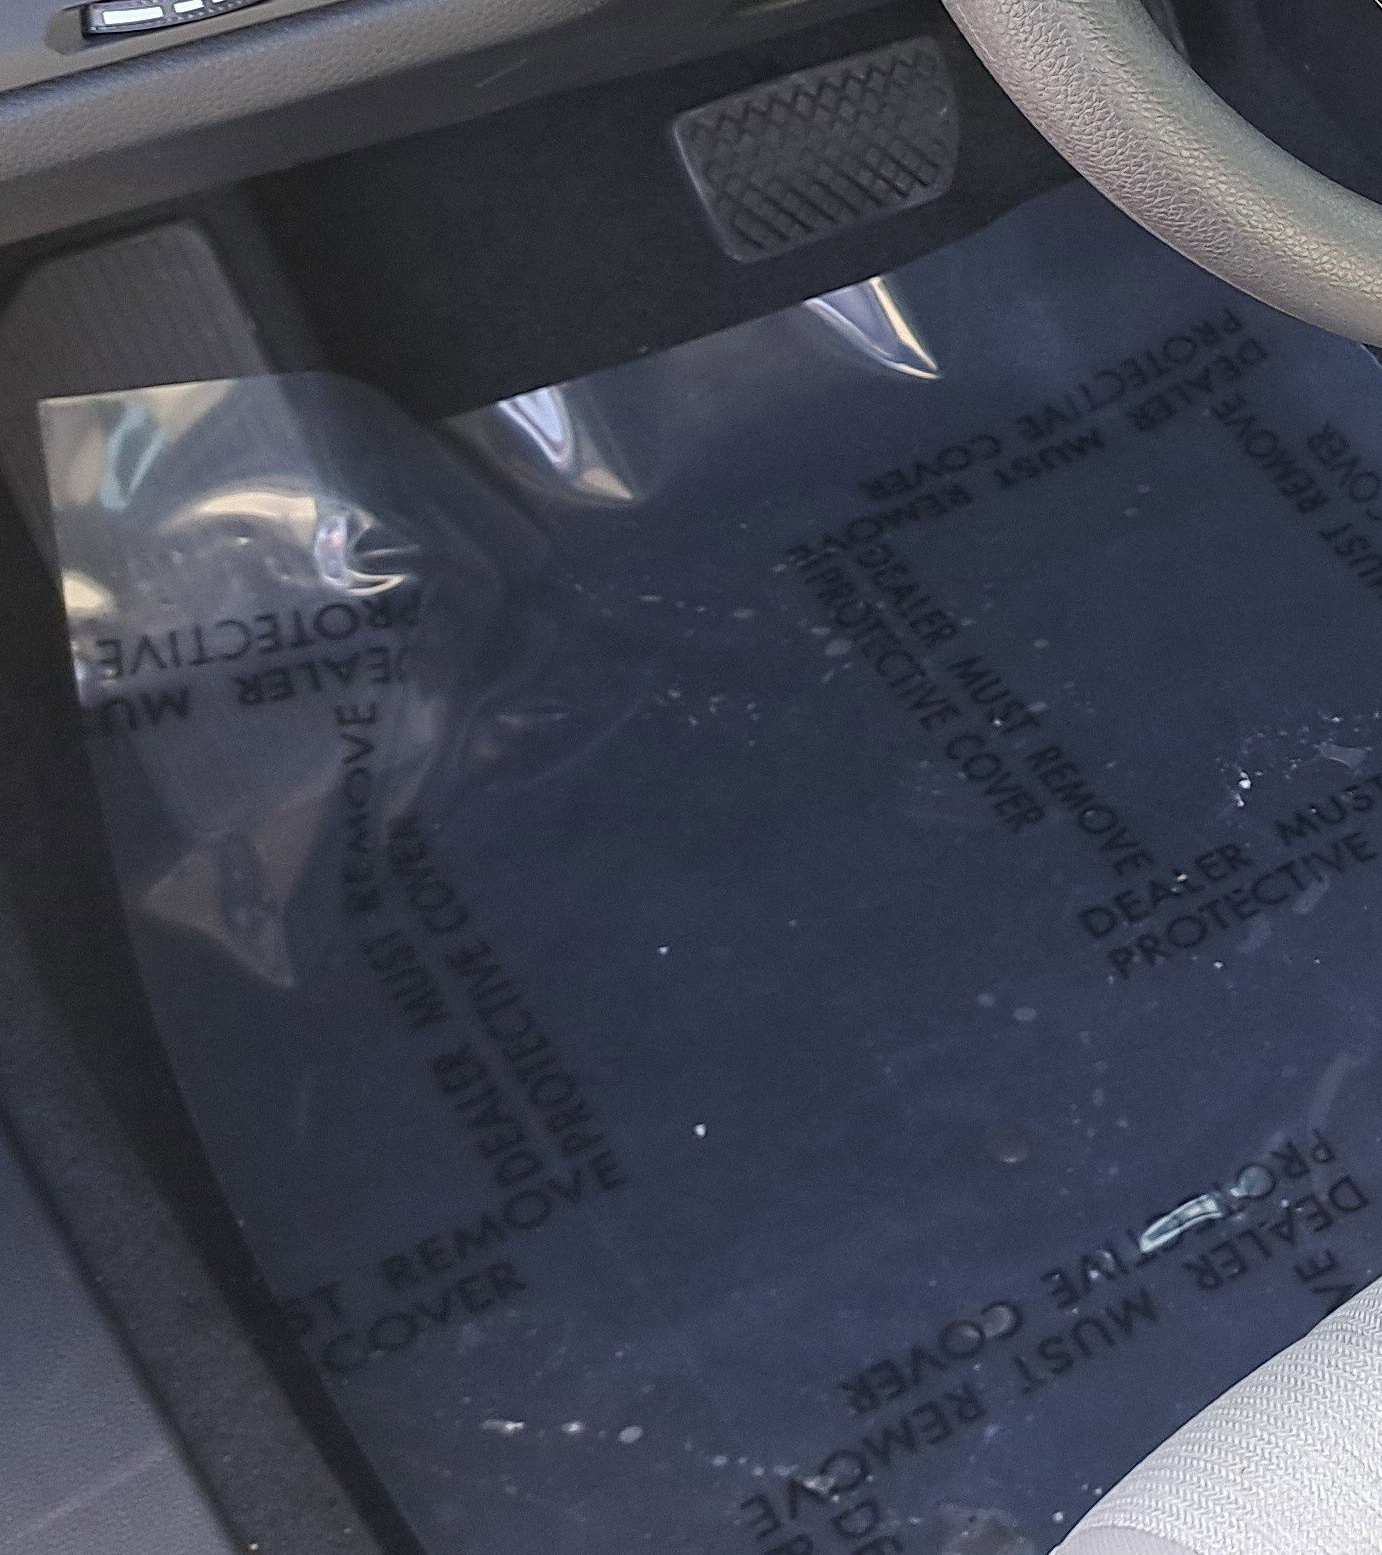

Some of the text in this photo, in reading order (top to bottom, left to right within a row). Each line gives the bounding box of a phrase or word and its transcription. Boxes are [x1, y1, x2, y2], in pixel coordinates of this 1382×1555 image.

[856, 305, 1246, 501] PROTECTIVE COVER
[1126, 335, 1269, 434] DEALER
[992, 426, 1107, 490] MUST
[1210, 393, 1333, 515] REMOVE
[944, 732, 1046, 835] COVER
[946, 654, 1043, 737] MUST
[1021, 744, 1155, 878] REMOVE
[1078, 841, 1256, 940] DEALER
[1106, 830, 1380, 981] PROTECTIVE
[378, 1148, 634, 1294] REMOVE
[1181, 1173, 1371, 1294] DEALER
[321, 1260, 529, 1374] COVER
[838, 1297, 1025, 1418] COVER
[1011, 1287, 1161, 1397] MUST
[739, 1381, 988, 1544] REMOVE
